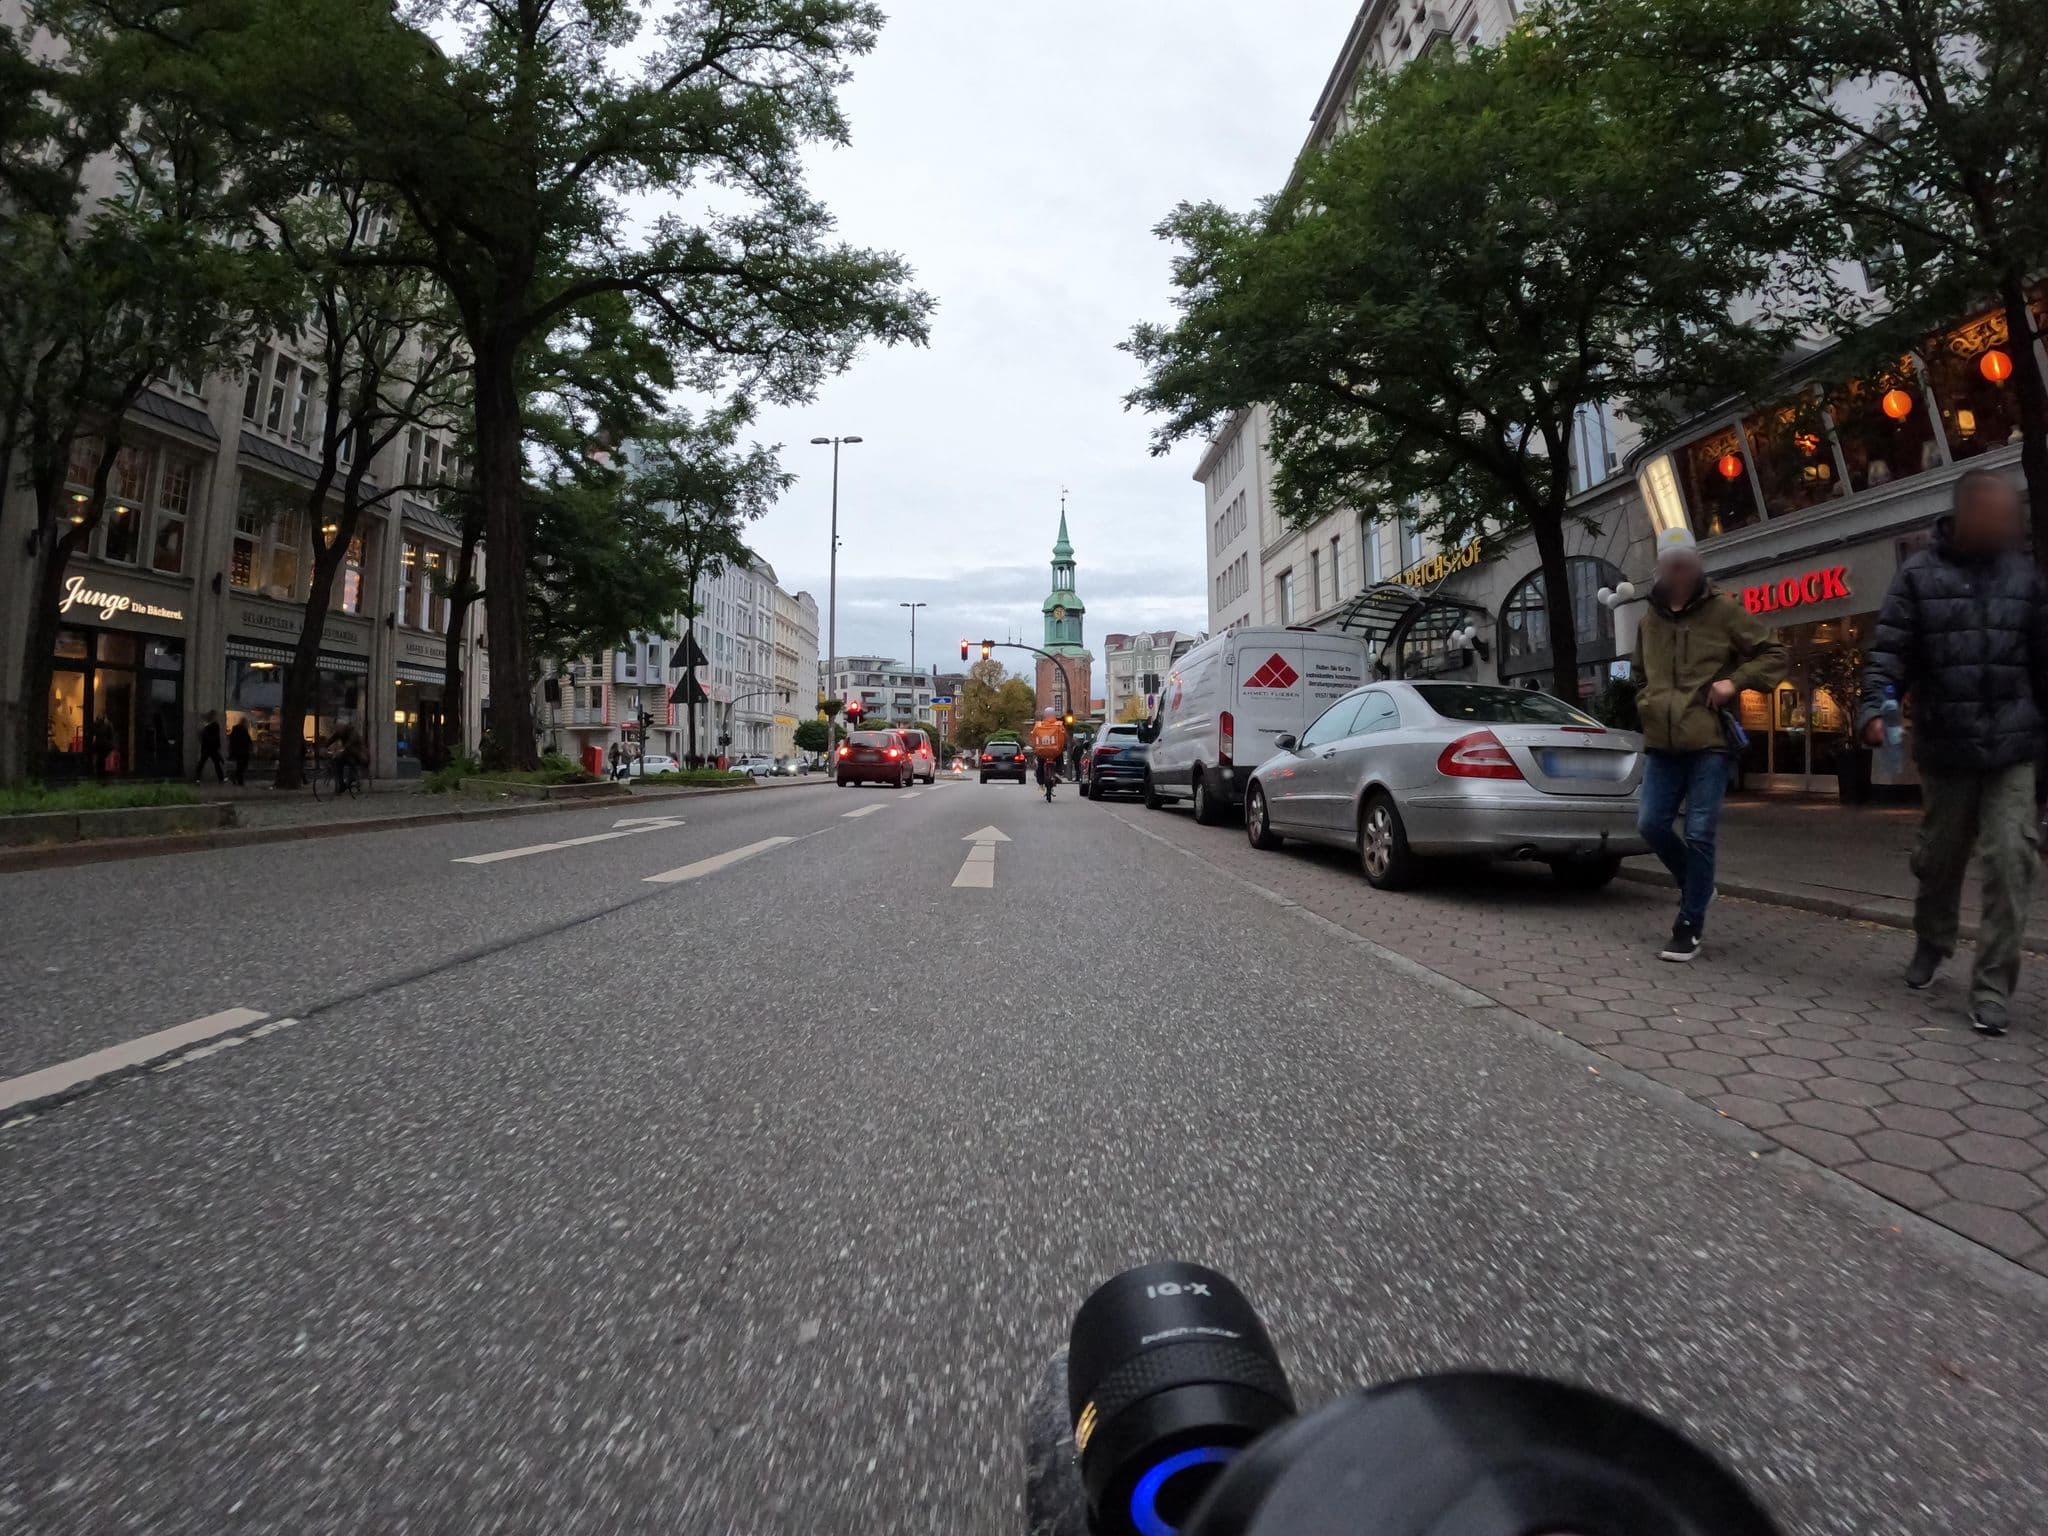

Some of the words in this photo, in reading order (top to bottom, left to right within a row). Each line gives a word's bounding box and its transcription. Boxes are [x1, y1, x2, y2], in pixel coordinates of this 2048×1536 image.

[59, 576, 129, 620] Junge
[131, 602, 146, 614] Die
[1743, 565, 1849, 614] BLOCK
